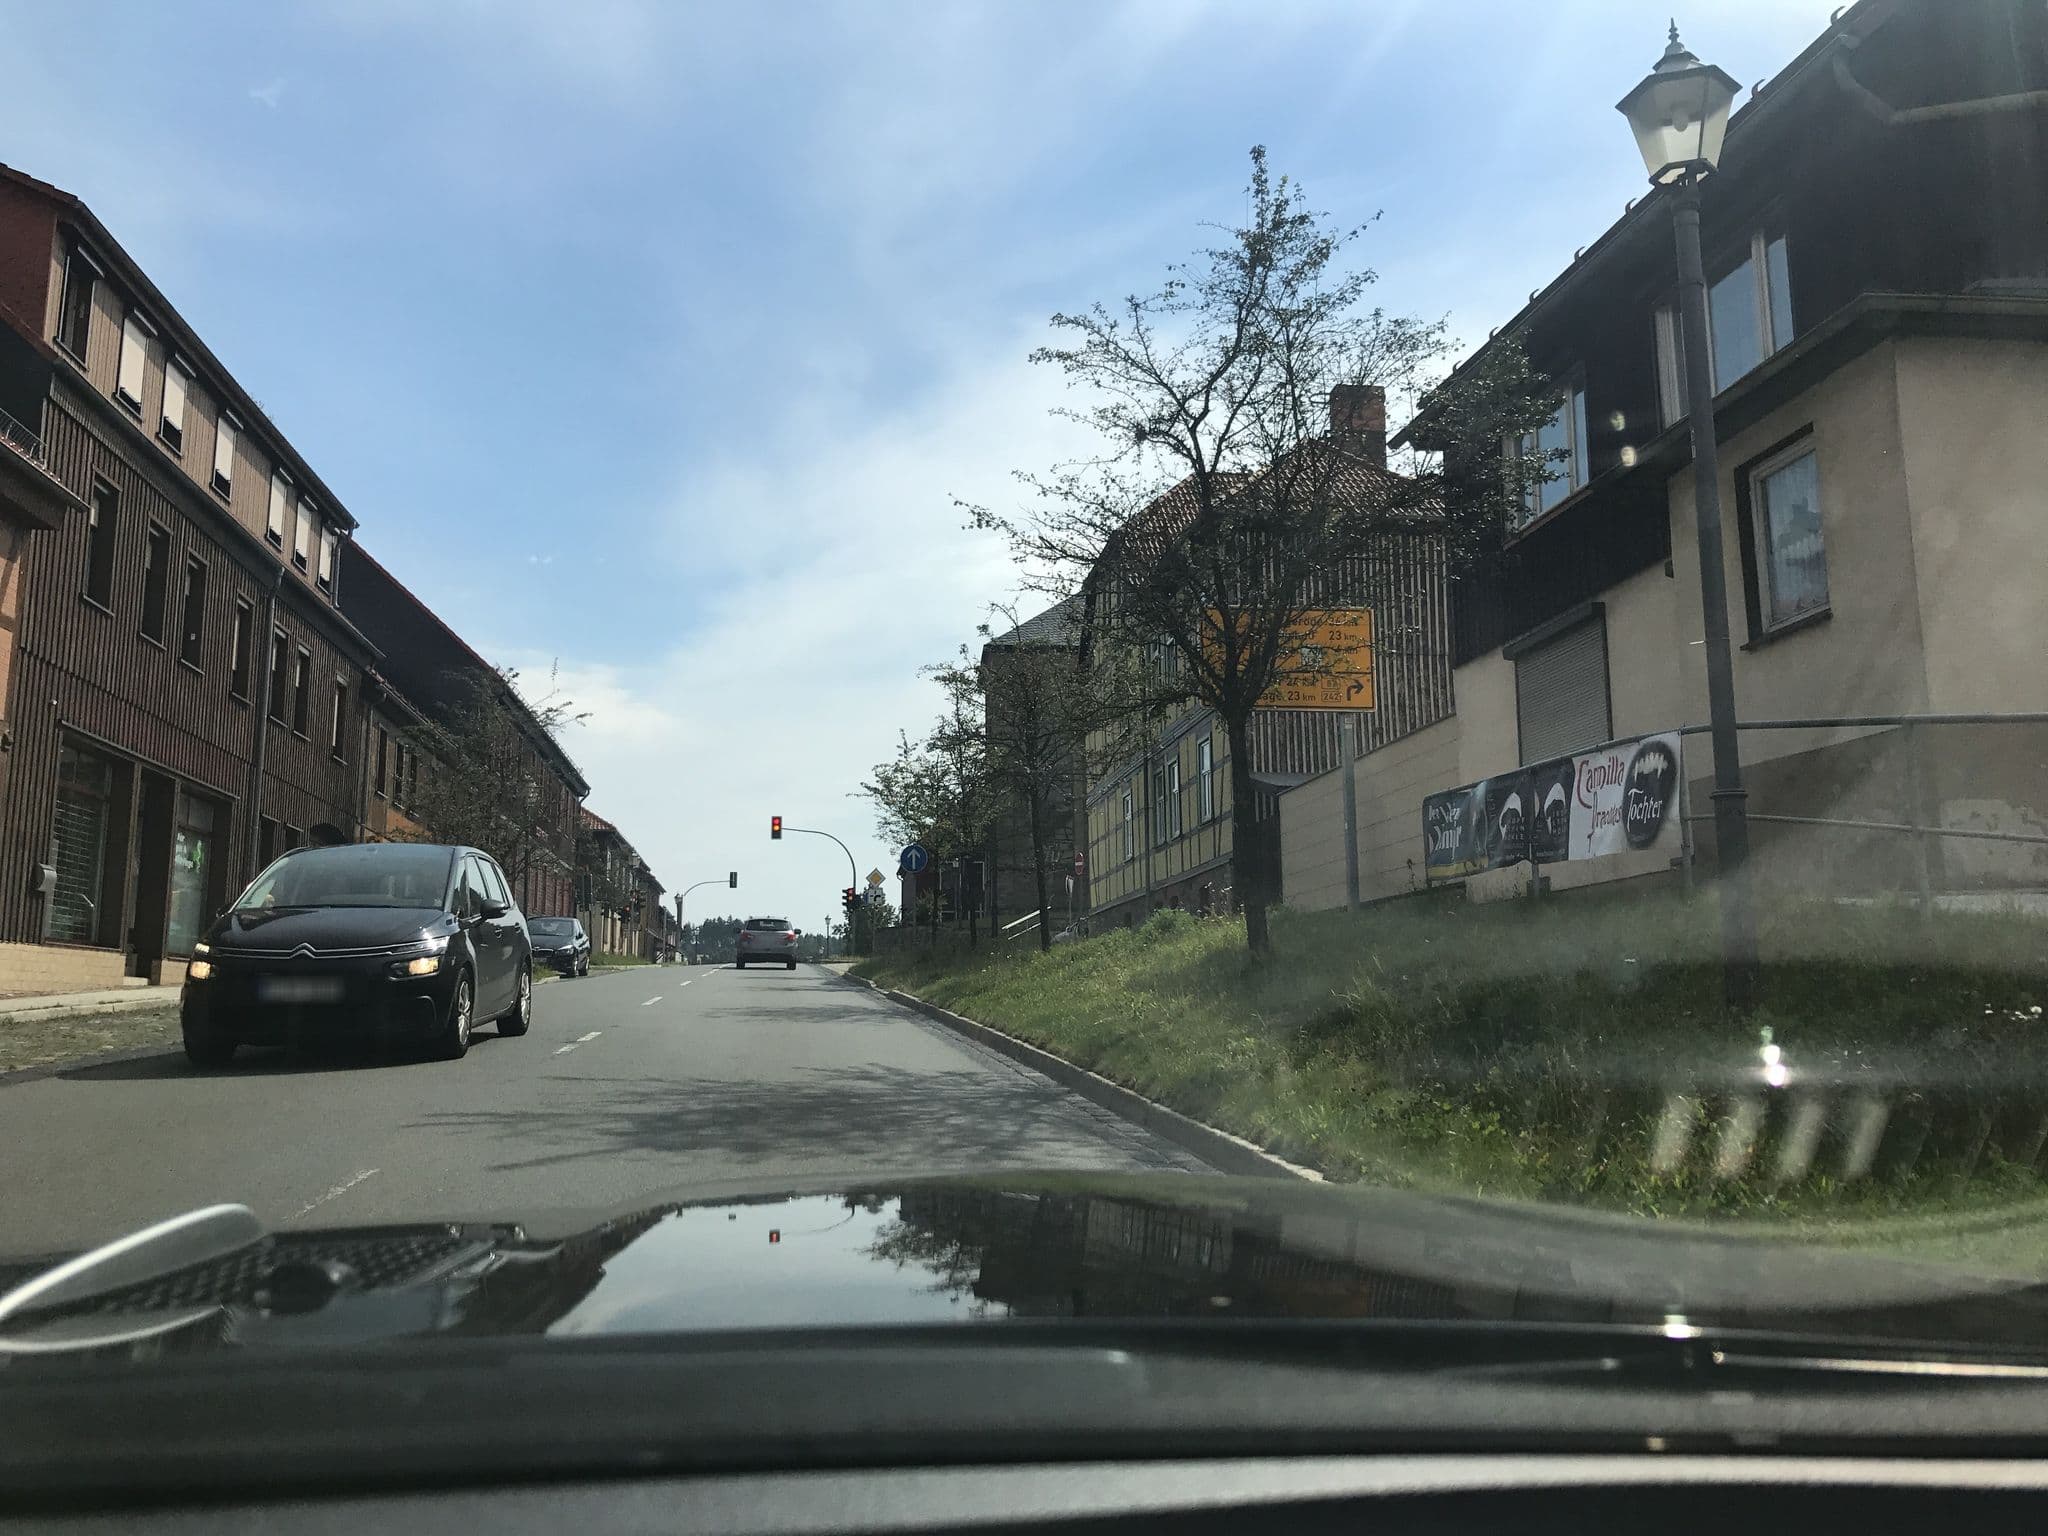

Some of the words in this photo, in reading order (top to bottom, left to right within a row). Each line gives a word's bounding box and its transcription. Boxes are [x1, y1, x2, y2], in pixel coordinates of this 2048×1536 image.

[1328, 630, 1342, 641] 23
[1344, 632, 1358, 641] km
[1287, 691, 1300, 701] 23
[1302, 693, 1316, 701] km
[1323, 692, 1340, 701] 242
[1627, 787, 1664, 833] Tochter
